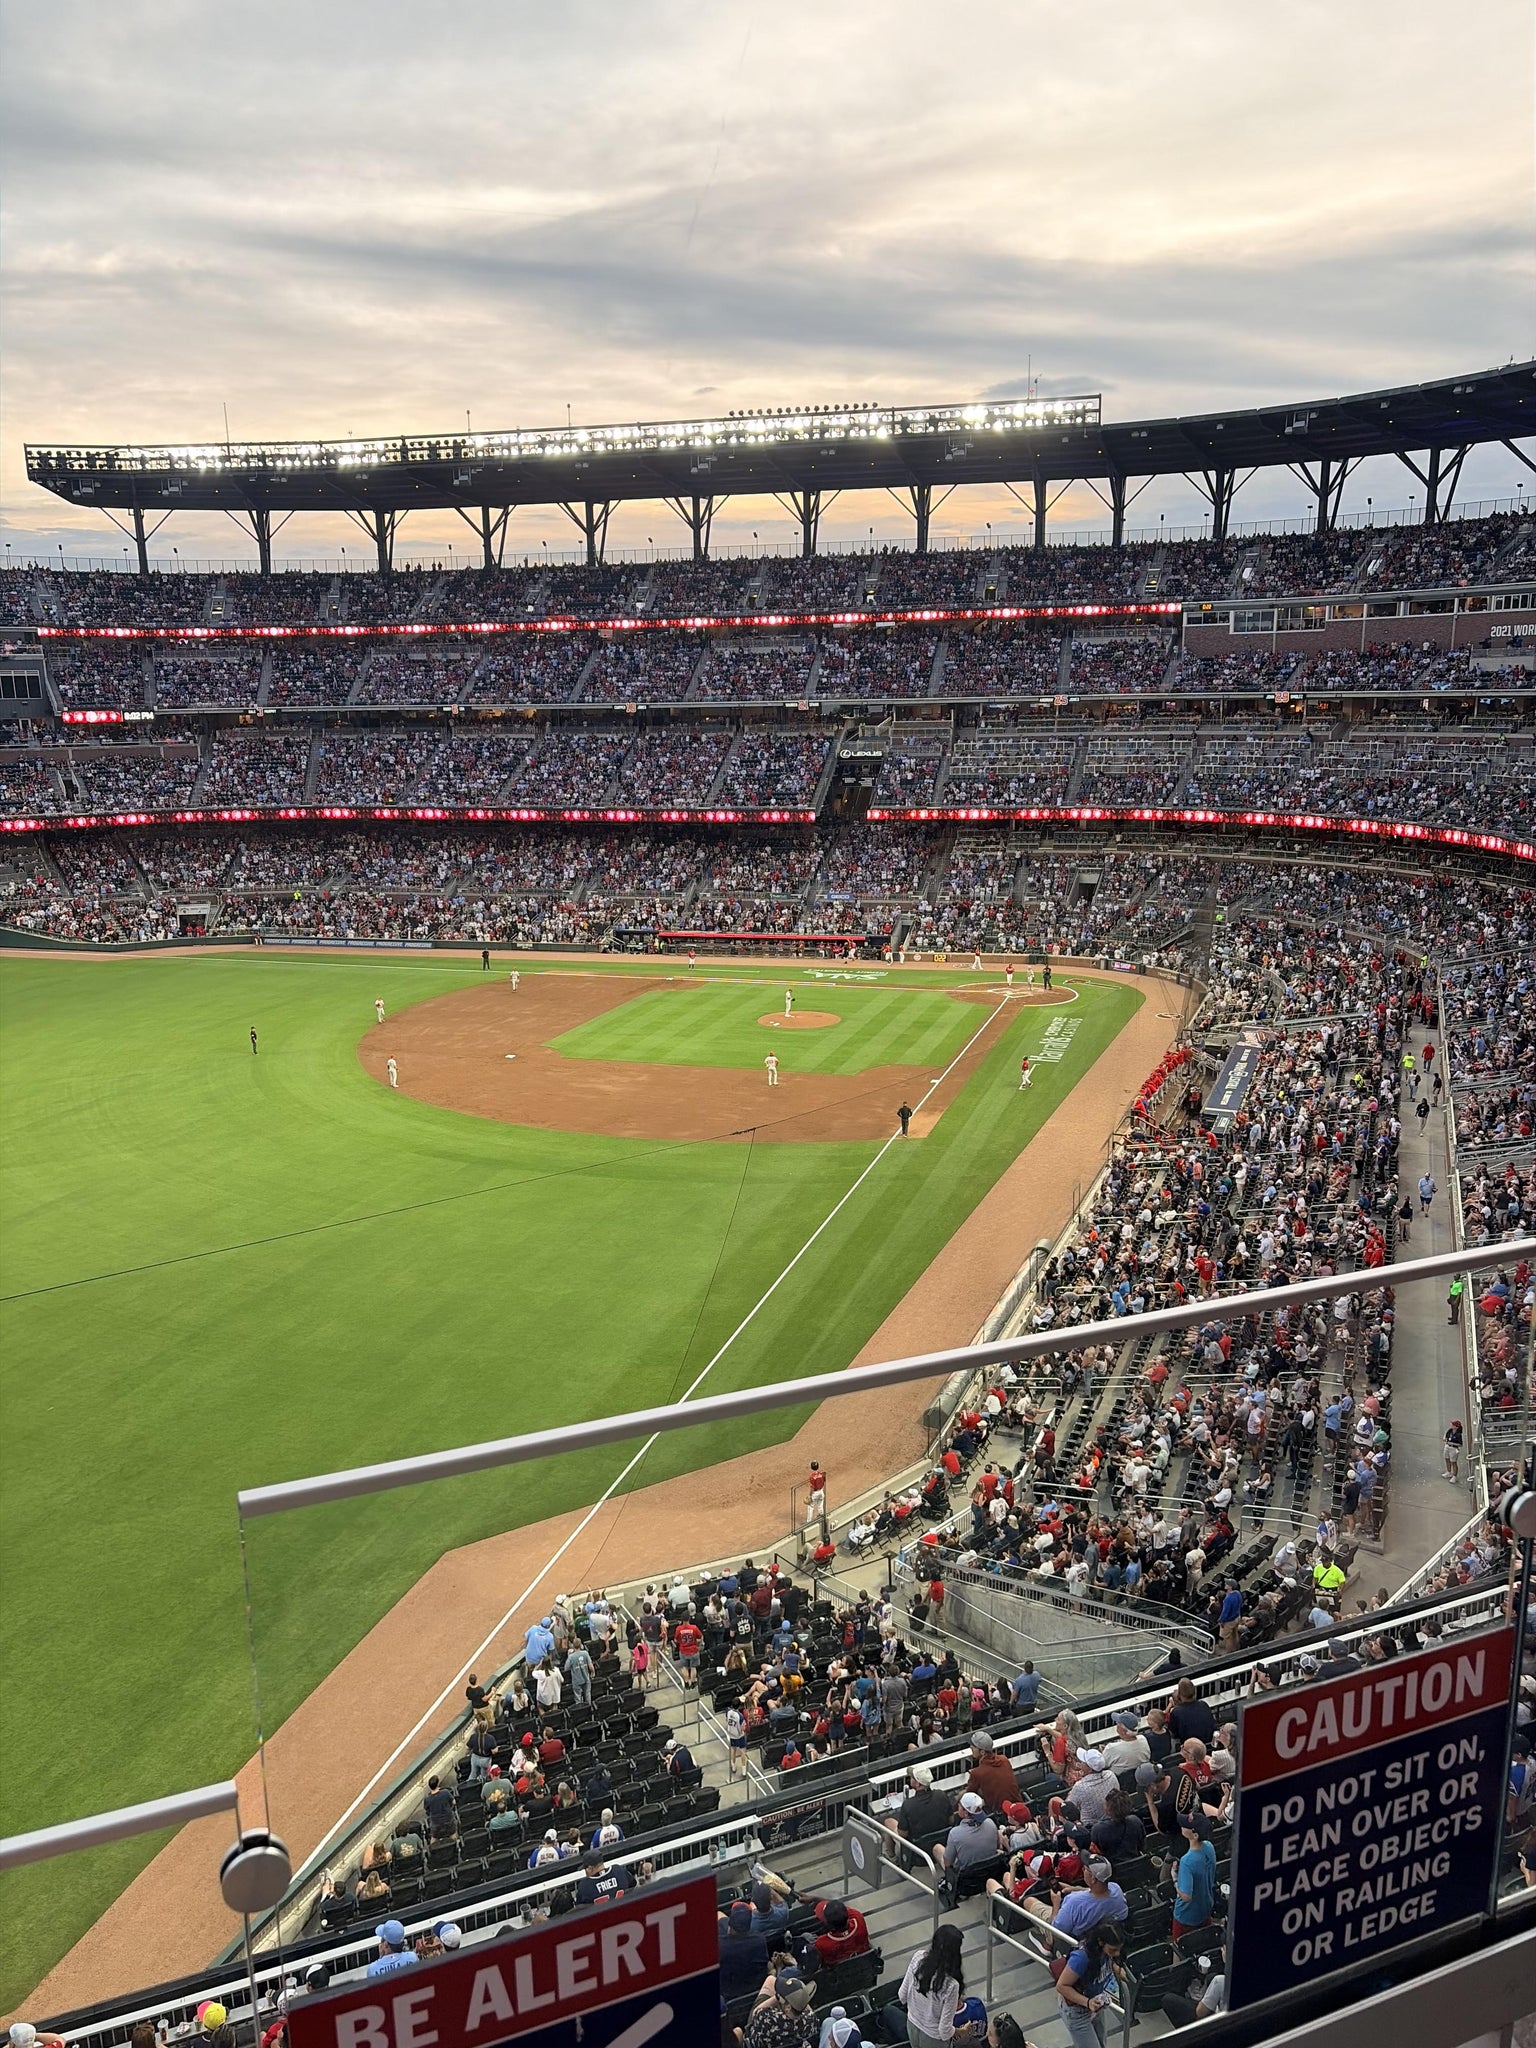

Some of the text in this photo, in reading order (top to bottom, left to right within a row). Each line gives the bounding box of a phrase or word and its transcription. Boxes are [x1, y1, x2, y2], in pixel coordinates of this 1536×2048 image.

[1490, 625, 1511, 637] 2021
[124, 711, 154, 720] 8:02 PM
[256, 706, 264, 717] 3
[1054, 694, 1069, 706] 25
[738, 1626, 751, 1635] 99
[1275, 1650, 1486, 1759] CAUTION
[1260, 1735, 1487, 1834] DO NOT SIT ON,
[1264, 1771, 1480, 1871] LEAN OVER OR
[540, 1853, 555, 1861] OLSON
[1253, 1805, 1483, 1912] PLACE OBJECTS
[596, 1877, 619, 1894] FRIED
[1282, 1852, 1452, 1935] ON RAILING
[1291, 1890, 1438, 1967] OR LEDGE
[334, 1903, 688, 2048] BE ALERT
